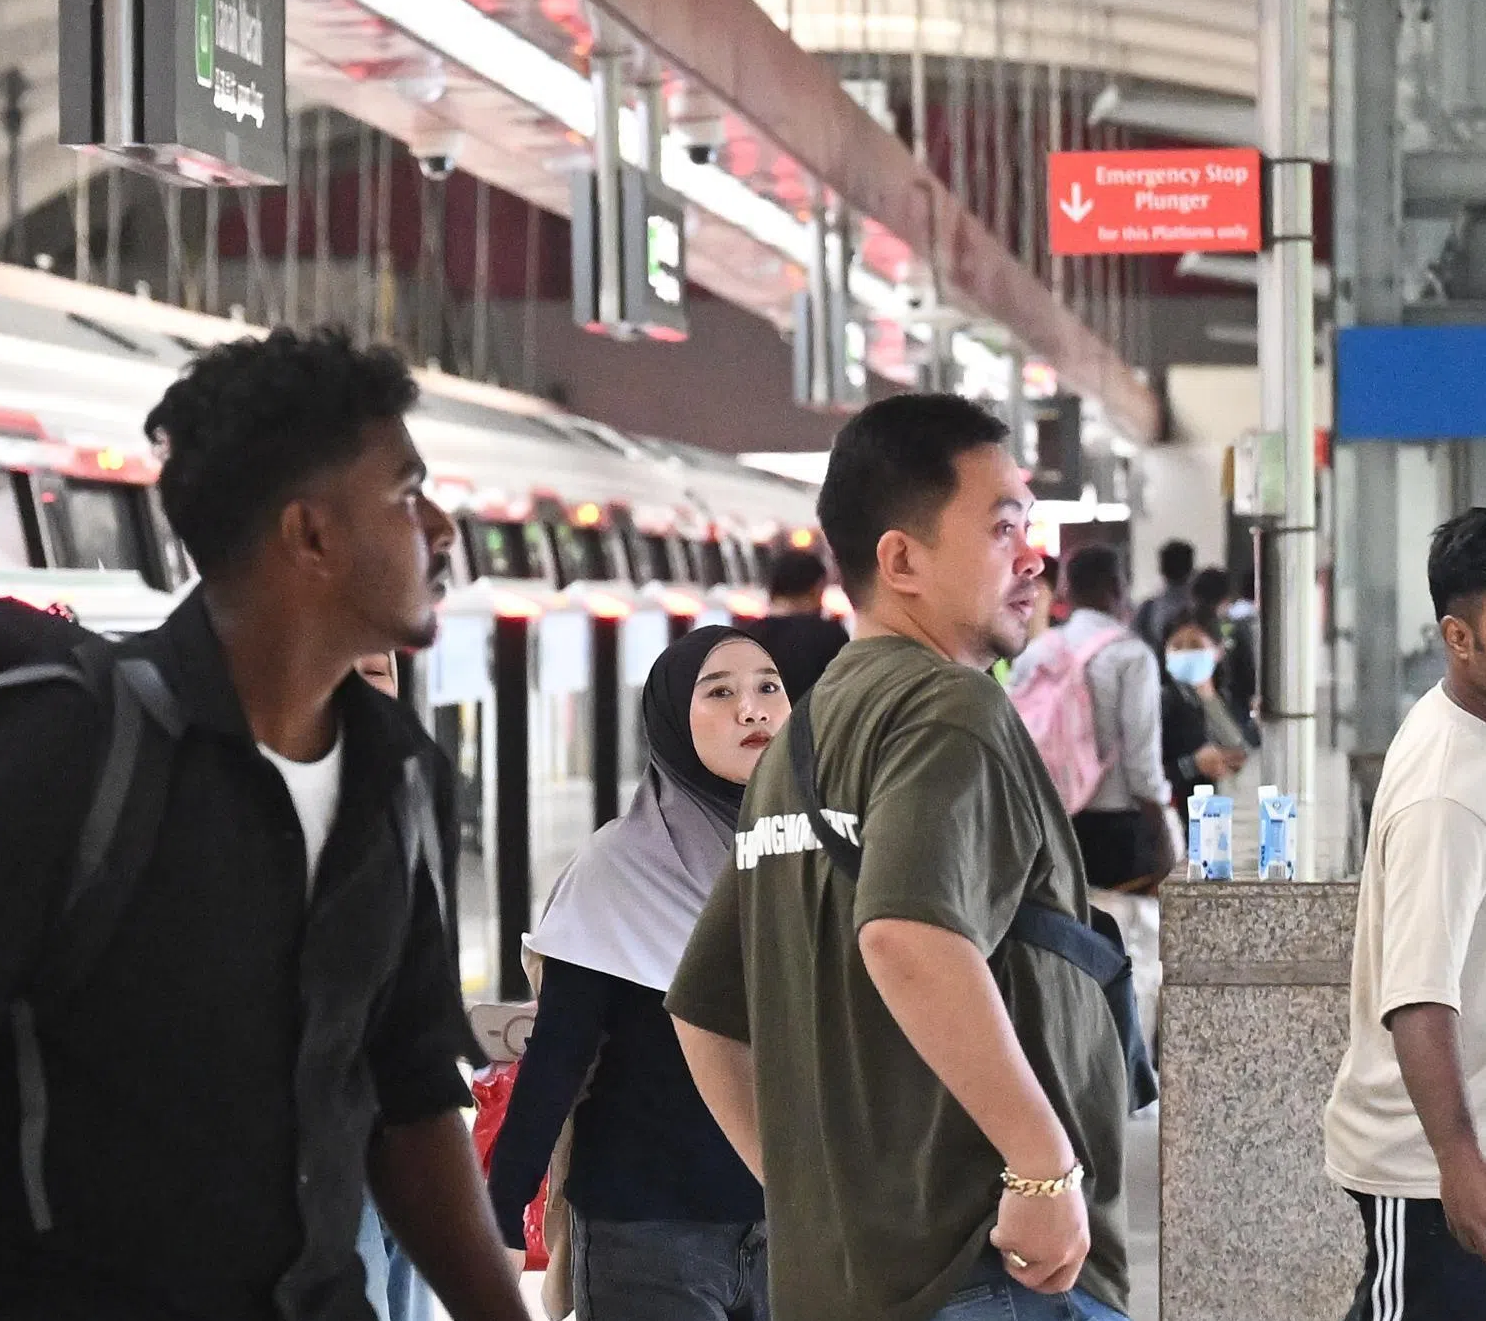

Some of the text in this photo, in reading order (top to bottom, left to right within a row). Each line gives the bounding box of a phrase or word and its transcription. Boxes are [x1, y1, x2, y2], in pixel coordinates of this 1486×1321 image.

[1096, 163, 1249, 187] Emergency Stop
[1135, 191, 1210, 213] Plunger
[1098, 225, 1248, 241] for this Platform only
